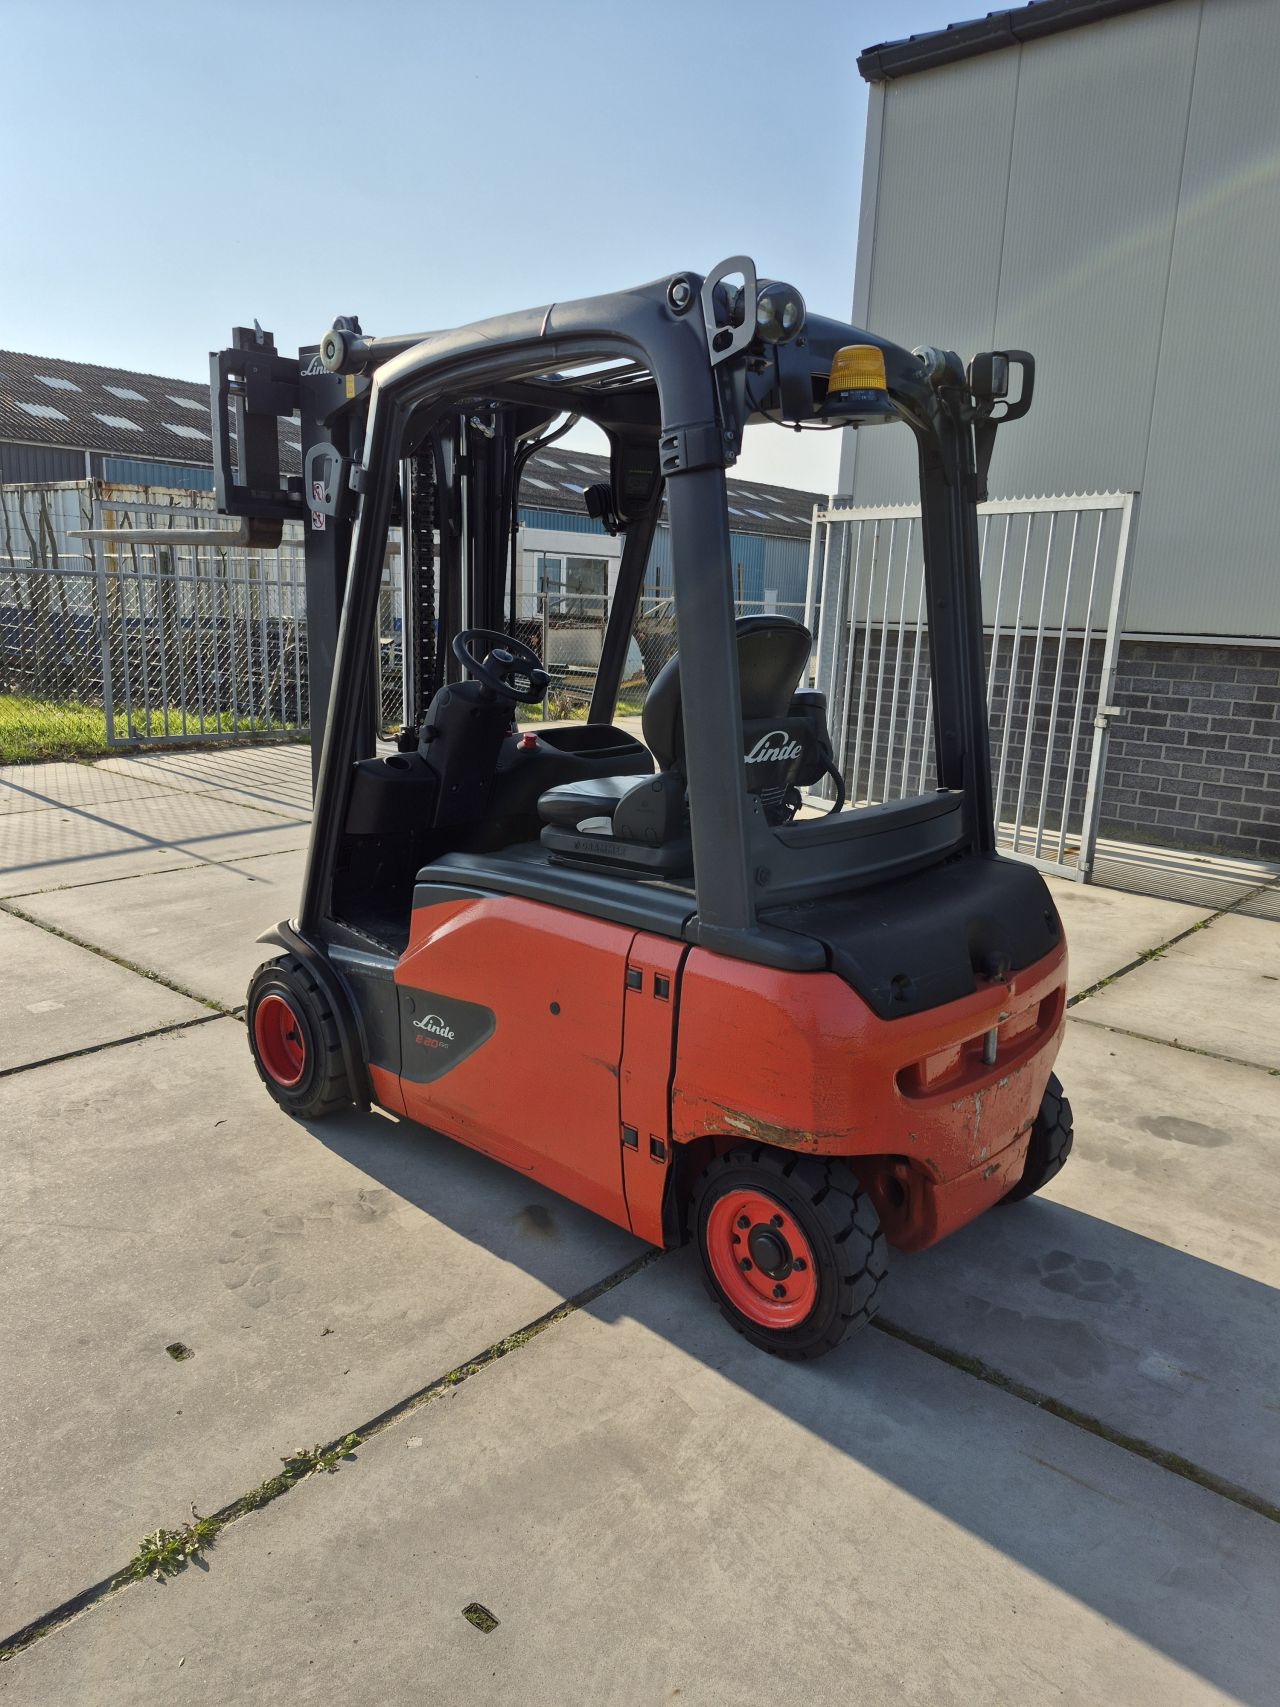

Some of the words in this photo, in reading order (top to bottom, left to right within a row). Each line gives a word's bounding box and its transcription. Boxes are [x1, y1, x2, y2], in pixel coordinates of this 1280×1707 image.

[300, 355, 336, 377] Lin
[743, 730, 802, 763] Linde
[412, 1014, 455, 1040] Linde
